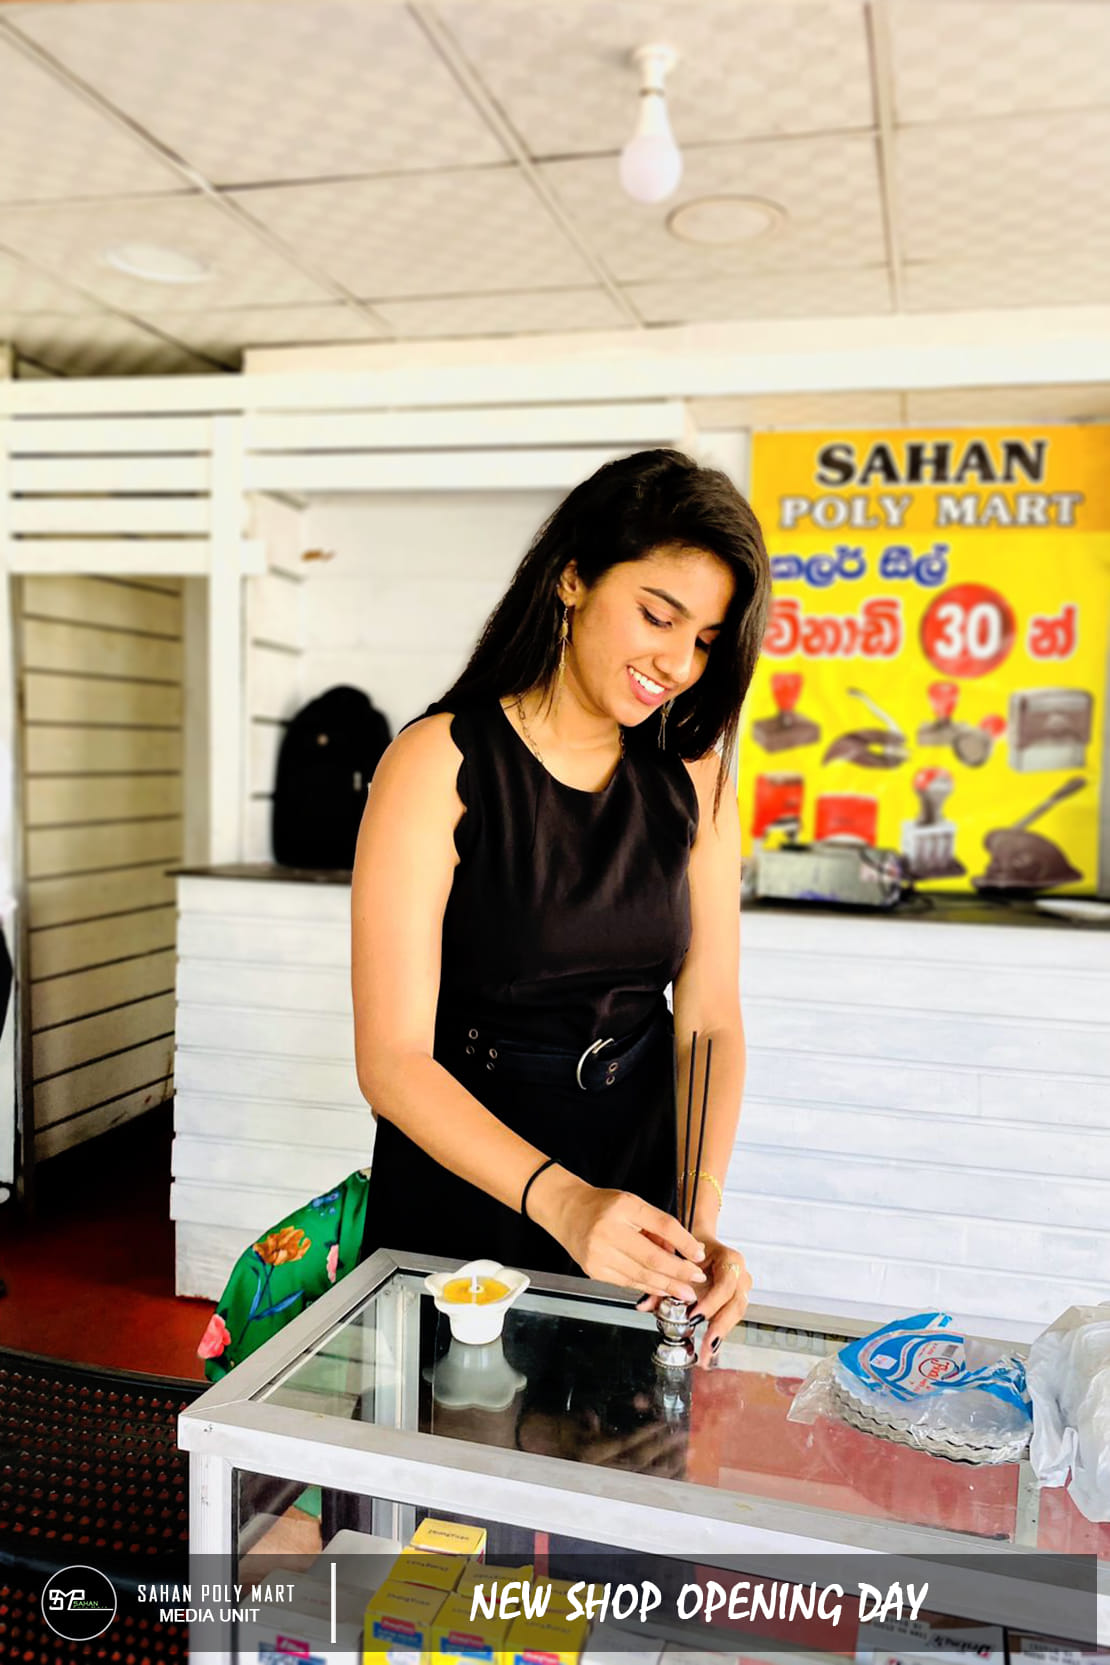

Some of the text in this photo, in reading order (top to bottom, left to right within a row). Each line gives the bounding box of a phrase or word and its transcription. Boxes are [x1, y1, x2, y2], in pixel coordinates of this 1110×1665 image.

[816, 440, 1047, 486] SAHAN
[779, 494, 1083, 529] POLY MART
[934, 602, 1004, 660] 30
[1028, 604, 1078, 660] න්
